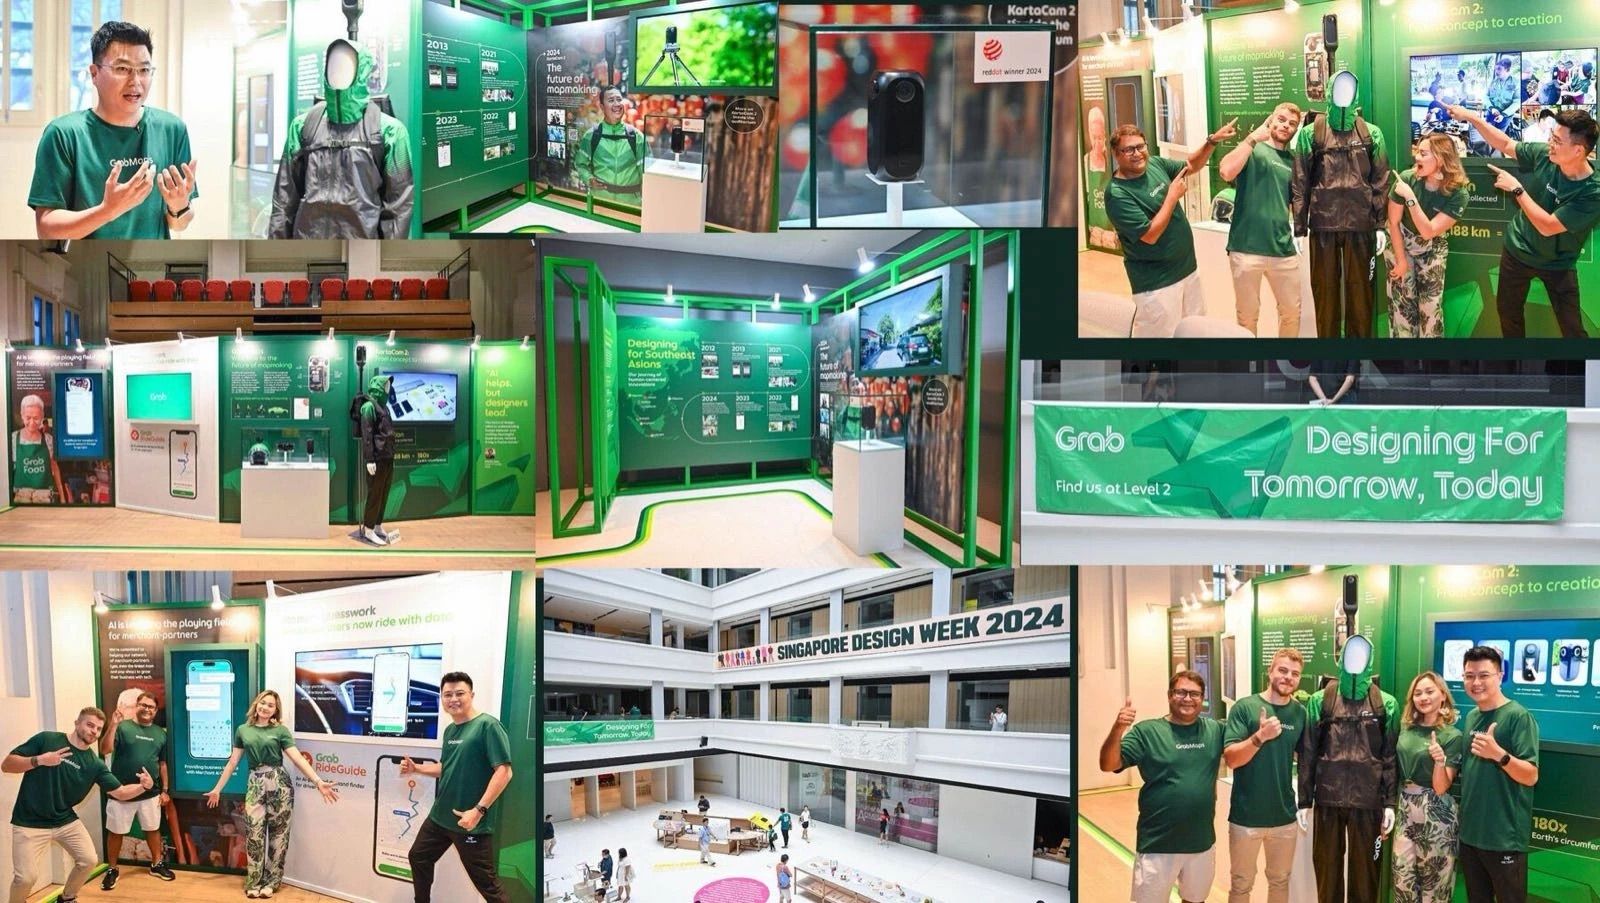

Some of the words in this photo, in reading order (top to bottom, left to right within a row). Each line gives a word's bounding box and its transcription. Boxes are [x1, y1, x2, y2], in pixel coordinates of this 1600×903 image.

[1008, 5, 1066, 16] KartaCam
[1069, 6, 1076, 16] 2
[1492, 18, 1504, 28] to
[1508, 13, 1562, 27] creation
[426, 40, 449, 51] 2013
[481, 49, 497, 57] 2021
[546, 63, 562, 72] The
[982, 67, 1002, 76] reddot
[547, 75, 571, 83] future
[574, 74, 583, 83] of
[547, 85, 598, 96] mapmaking
[436, 116, 457, 125] 2023
[1472, 226, 1490, 238] km
[628, 339, 678, 351] Designing
[628, 349, 643, 358] for
[645, 350, 695, 360] Southeast
[628, 360, 661, 369] Asians
[485, 399, 528, 408] designers
[1055, 425, 1125, 453] Grab
[1306, 425, 1475, 464] Designing
[1485, 426, 1544, 455] For
[23, 457, 44, 466] Grab
[1056, 480, 1083, 492] Find
[1086, 484, 1101, 493] us
[1105, 484, 1121, 494] at
[1124, 482, 1160, 495] Level
[1163, 484, 1171, 496] 2
[1244, 470, 1424, 504] Tomorrow,
[1433, 469, 1542, 506] Today
[1528, 581, 1542, 593] to
[163, 619, 177, 628] the
[179, 618, 212, 629] playing
[214, 617, 234, 626] fiel
[376, 618, 396, 628] ride
[399, 614, 422, 625] with
[109, 631, 120, 640] for
[778, 636, 849, 660] SINGAPORE
[852, 624, 914, 651] DESIGN
[919, 616, 980, 643] WEEK
[986, 603, 1065, 635] 2024
[316, 753, 339, 763] Grab
[316, 763, 366, 776] RideGuide
[1533, 816, 1568, 834] 180x
[1532, 832, 1559, 843] Earth's
